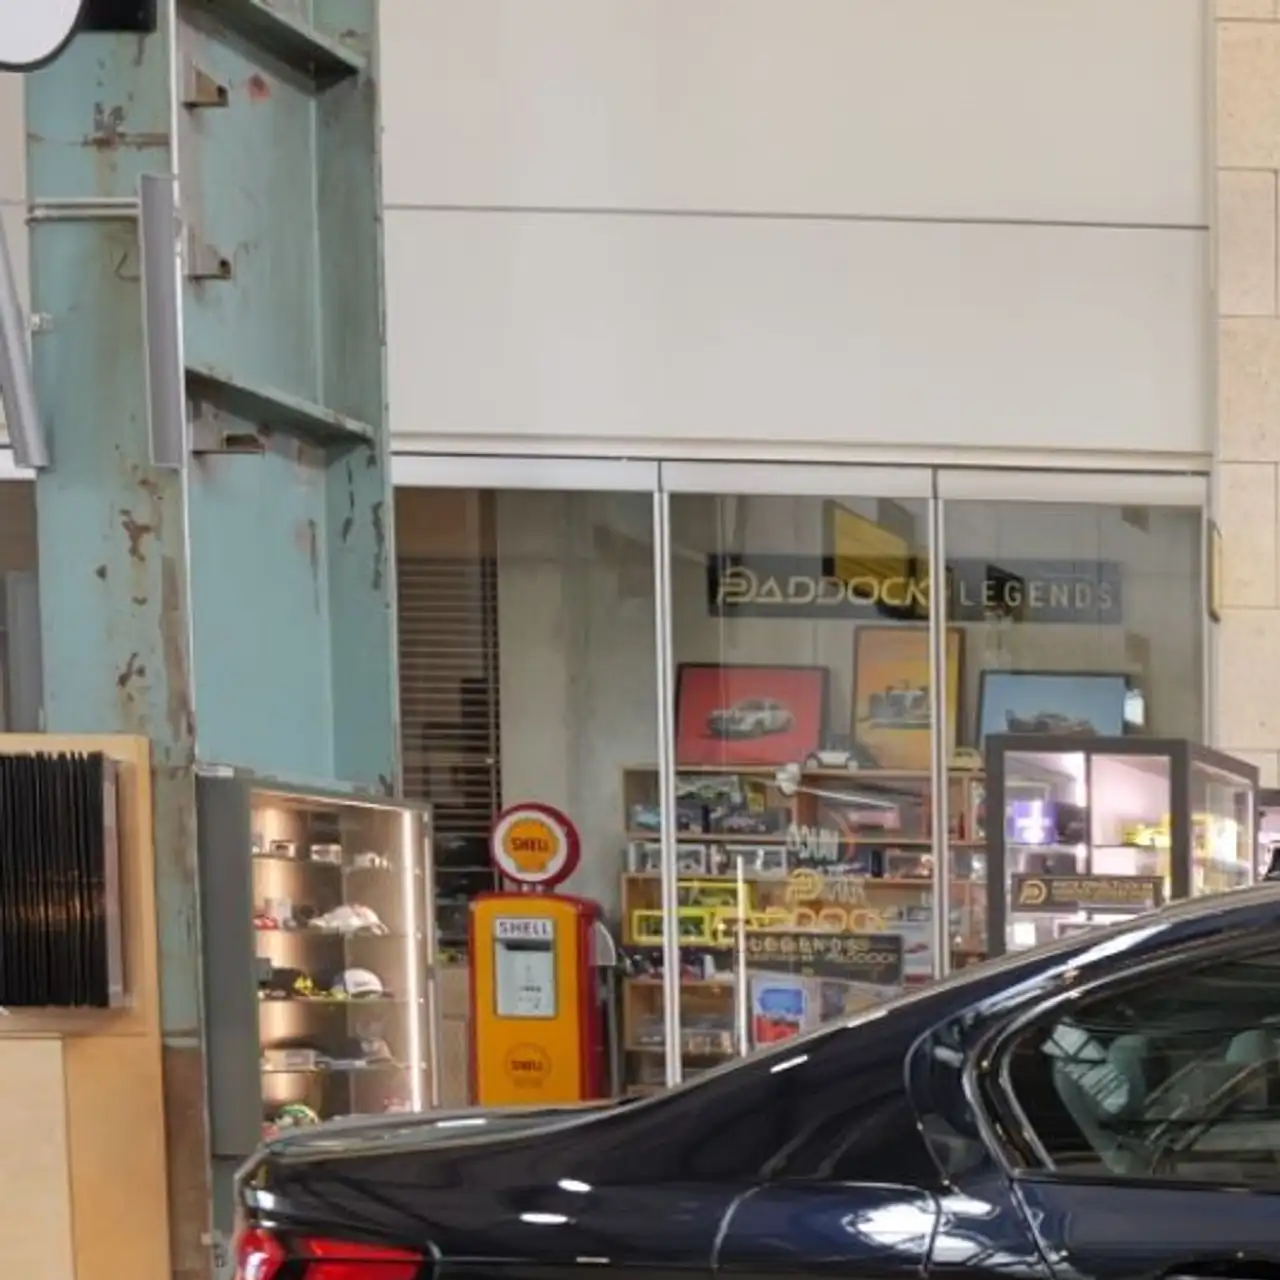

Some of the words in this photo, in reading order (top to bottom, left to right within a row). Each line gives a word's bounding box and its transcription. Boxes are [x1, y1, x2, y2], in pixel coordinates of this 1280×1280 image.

[958, 580, 1113, 609] LEGENDS
[511, 837, 550, 853] SHELL
[499, 919, 548, 936] SHELL
[511, 1060, 543, 1072] SHELL
